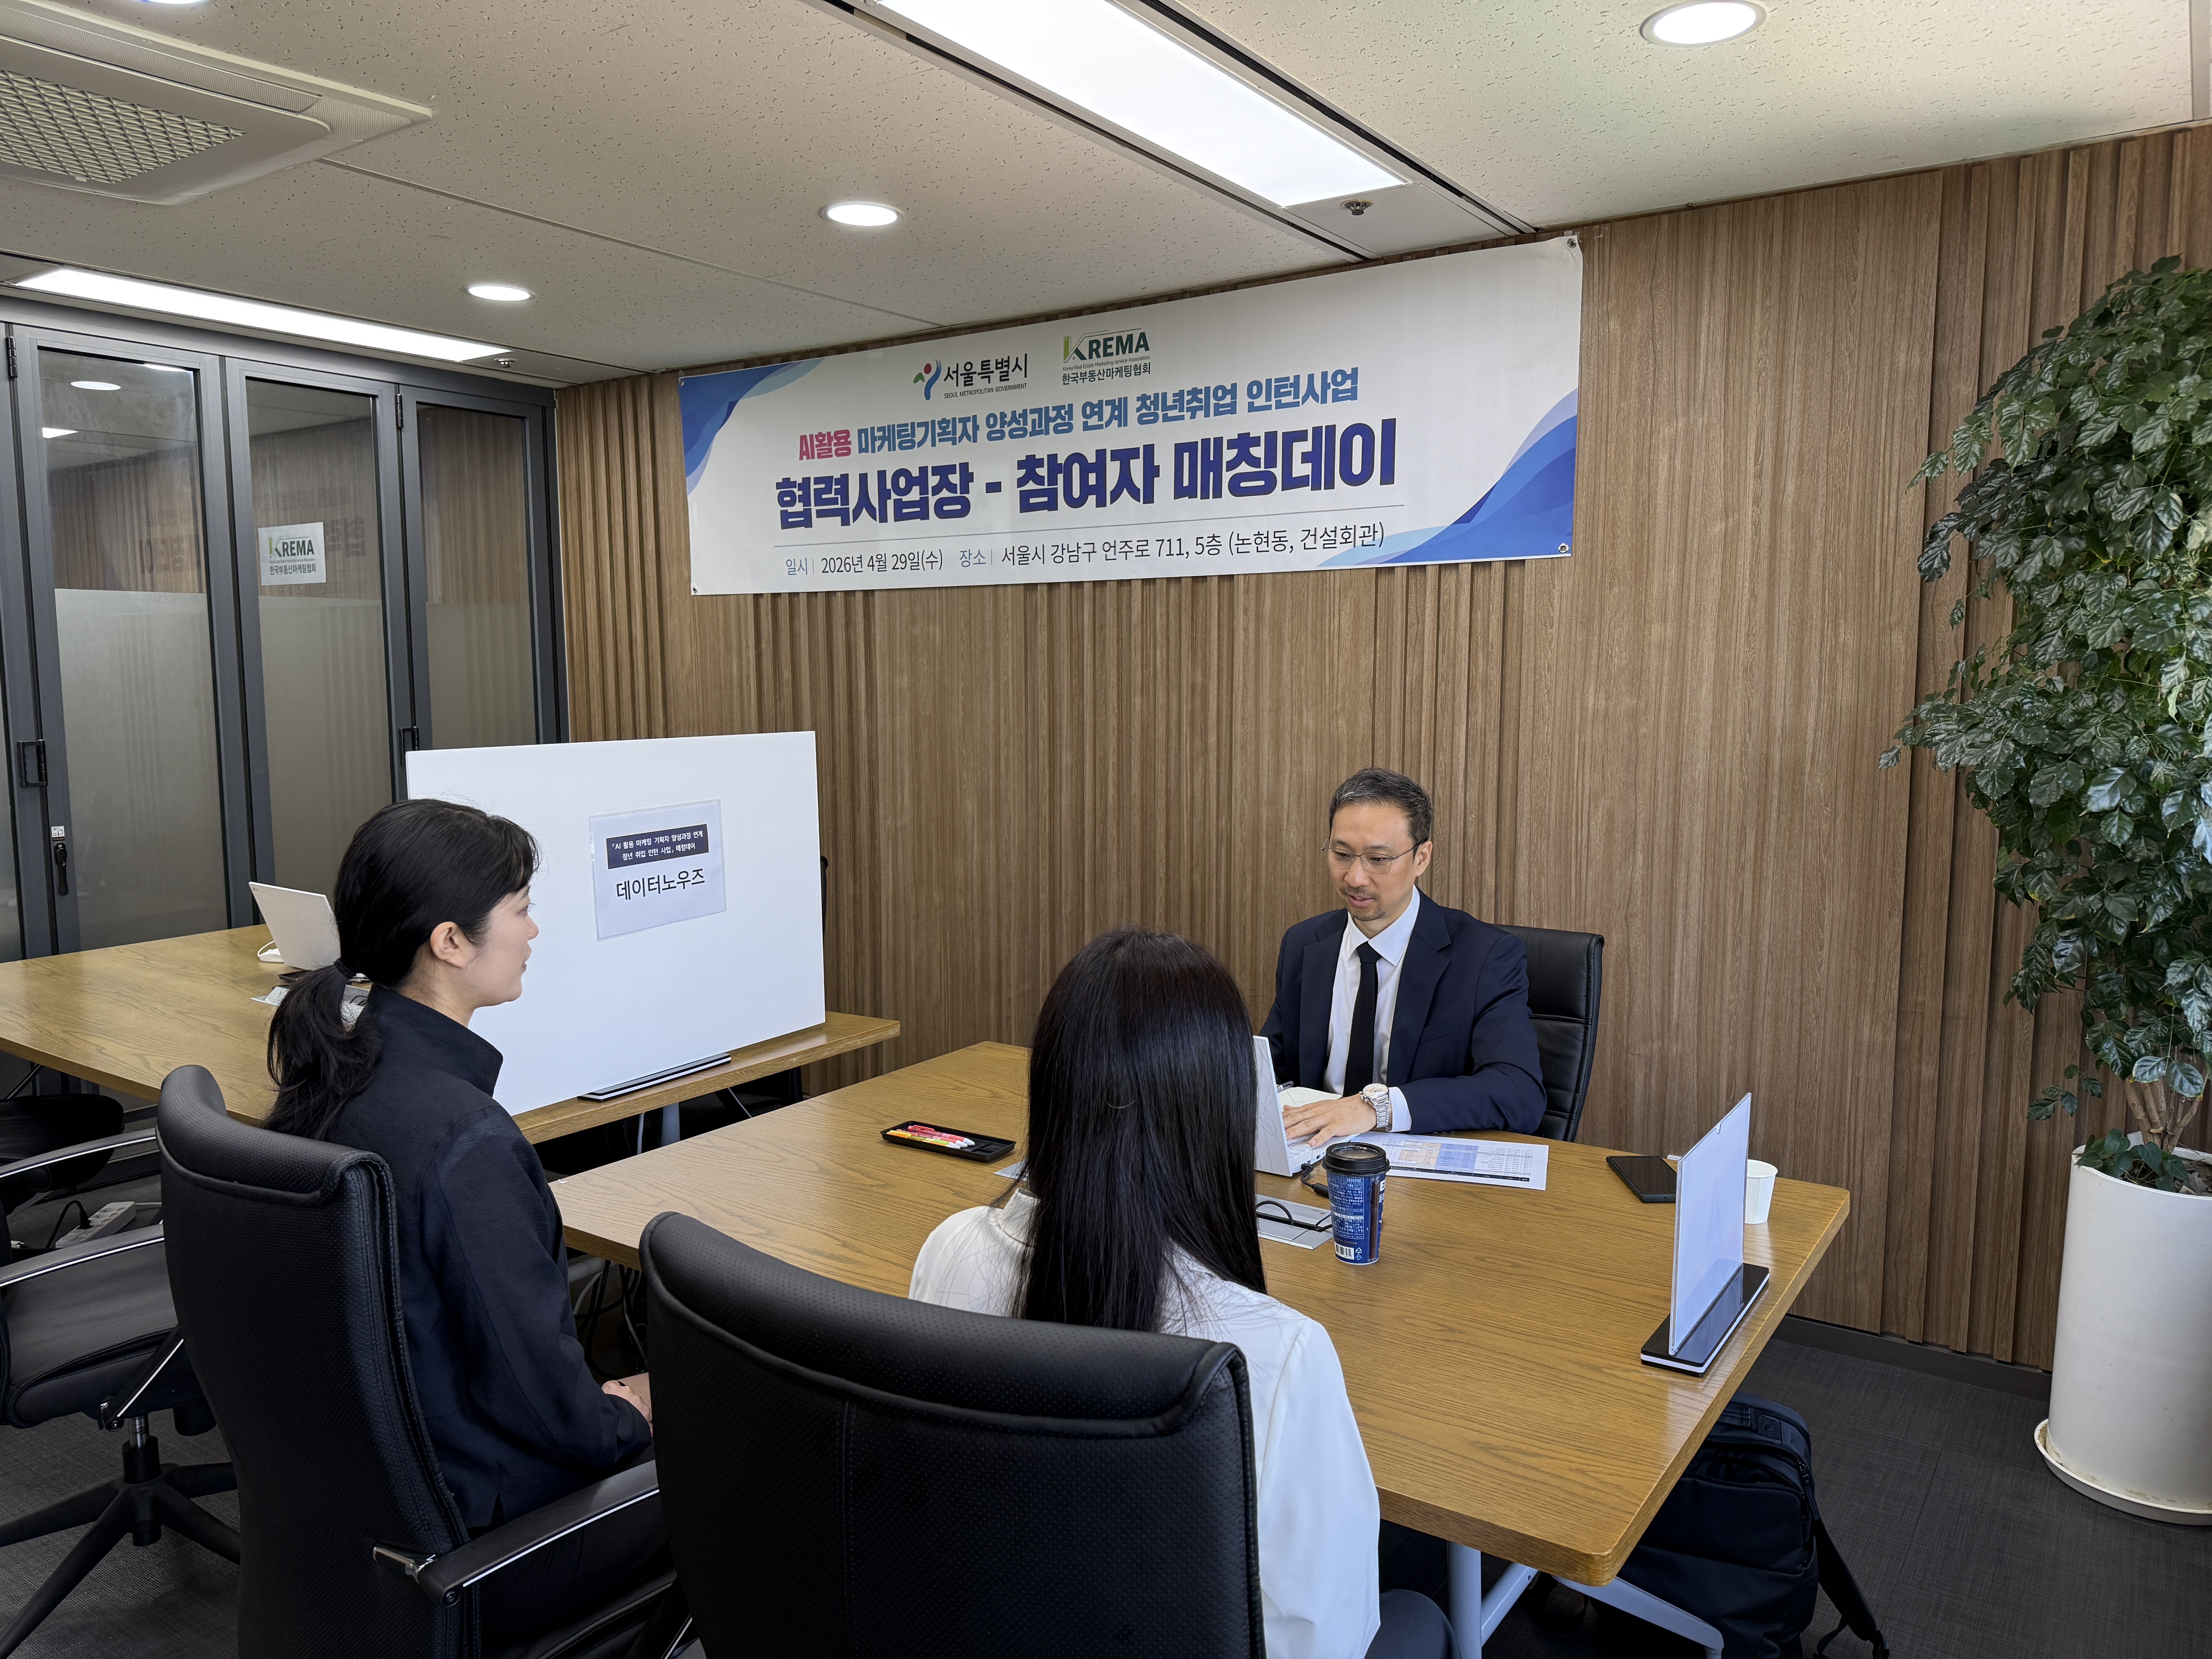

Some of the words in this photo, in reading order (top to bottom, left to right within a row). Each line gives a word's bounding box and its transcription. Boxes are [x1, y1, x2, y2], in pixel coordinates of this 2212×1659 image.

[1063, 331, 1149, 362] KREMA
[944, 353, 1027, 387] 서울특별시
[1062, 362, 1151, 385] 한국부동산마케팅협회
[960, 387, 994, 397] METROPOLITAN
[995, 383, 1027, 392] GOVERNMENT
[799, 429, 852, 460] AI활용
[857, 415, 979, 454] 마케팅기획자
[986, 403, 1073, 442] 양성과정
[1081, 396, 1128, 431] 연계
[1136, 382, 1237, 425] 청년취업
[1247, 367, 1358, 413] 인턴사업
[776, 462, 974, 530] 협력사업장
[1017, 443, 1160, 513] 참여자
[1173, 417, 1396, 500] 매칭데이
[268, 536, 314, 558] KREMA
[959, 549, 986, 568] 장소
[1001, 544, 1045, 566] 서울시
[1051, 542, 1097, 564] 강남구
[1102, 539, 1150, 561] 언주로
[1156, 538, 1190, 559] 711,
[1195, 534, 1223, 556] 5층
[1229, 530, 1294, 556] (논현동,
[1300, 521, 1384, 550] 건설회관)
[270, 563, 316, 575] 한국부동산마케팅협회
[786, 557, 808, 575] 일시
[821, 555, 863, 574] 2026년
[867, 553, 887, 572] 4월
[891, 549, 943, 571] 29일(수)
[622, 852, 633, 861] 청년
[635, 850, 646, 859] 취업
[648, 848, 658, 857] 인턴
[676, 842, 696, 852] 매칭데이
[623, 841, 634, 849] 활용
[636, 838, 652, 847] 마케팅
[654, 836, 670, 844] 기획자
[671, 832, 691, 842] 양성과정
[693, 830, 703, 838] 연계
[616, 868, 705, 900] 데이터노우즈
